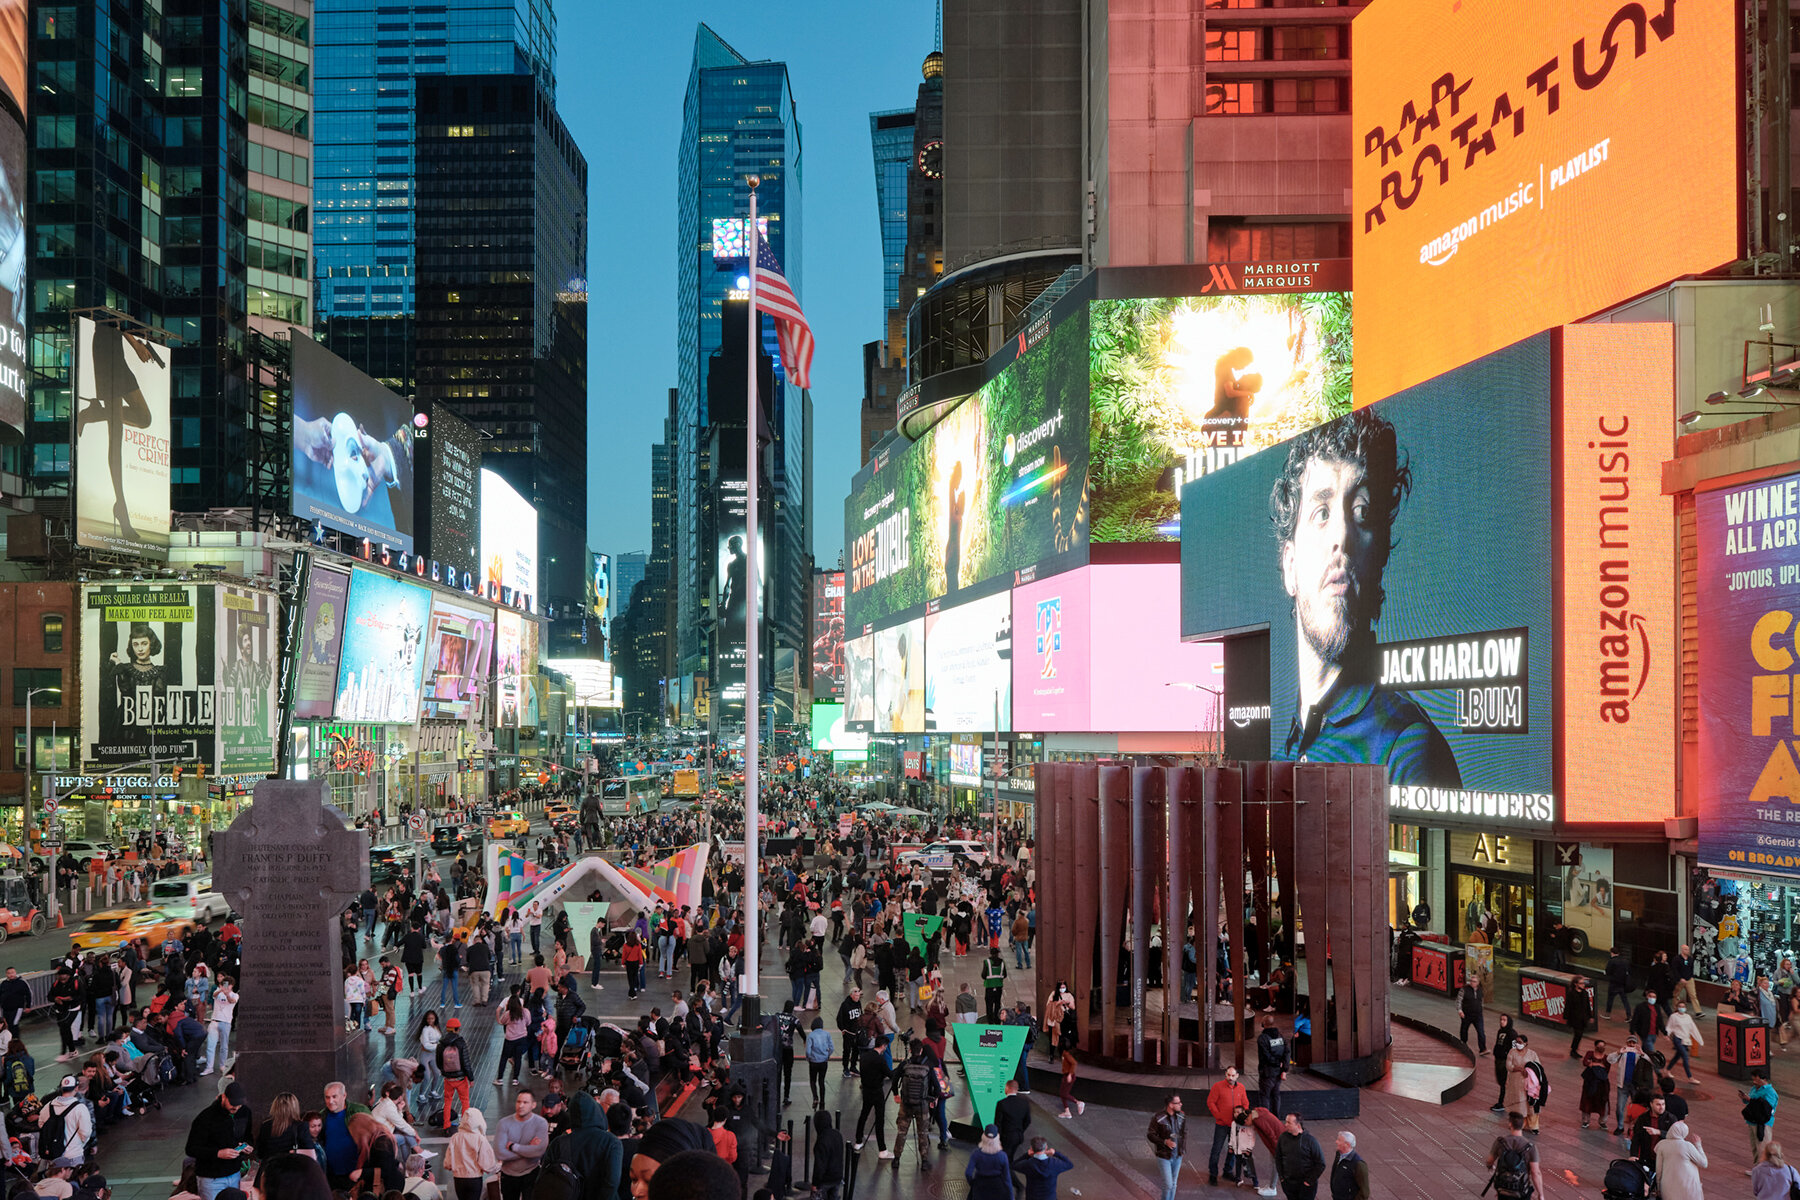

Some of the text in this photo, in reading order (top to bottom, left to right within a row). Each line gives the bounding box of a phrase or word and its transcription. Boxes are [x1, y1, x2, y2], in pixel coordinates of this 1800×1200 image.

[1549, 137, 1611, 191] PLAYLIST
[1419, 181, 1534, 264] amazon music
[1244, 262, 1321, 275] MARRIOTT
[1244, 276, 1312, 288] MARQUIS
[729, 290, 750, 300] 202
[1028, 309, 1052, 336] MARRIOTT
[1028, 324, 1050, 347] MARQUIS
[124, 428, 169, 453] PERFECT
[414, 429, 427, 438] LG
[1016, 408, 1064, 453] discovery+
[137, 446, 169, 467] CRIME
[1018, 455, 1046, 478] stream now
[1725, 479, 1800, 526] WINNE
[852, 527, 875, 569] LOVE
[1725, 517, 1800, 556] ALL ACR
[362, 536, 425, 577] 1540
[431, 559, 533, 614] BROADWAY
[852, 559, 875, 594] IN THE
[1588, 415, 1631, 724] amazon music
[89, 592, 187, 606] TIMES SQUARE CAN REALLY
[108, 607, 193, 619] MAKE YOU FEEL ALIVE!
[285, 605, 297, 653] MAC
[1750, 610, 1800, 672] C
[1380, 636, 1522, 686] JACK HARLOW
[279, 656, 290, 704] MAC
[122, 690, 213, 726] BEETLE
[1229, 706, 1261, 721] amazon
[1751, 673, 1800, 737] F
[275, 708, 284, 742] AC
[148, 744, 168, 754] GOOD
[329, 731, 376, 779] Disney
[105, 776, 180, 788] LUGGAGE
[1748, 738, 1800, 804] A
[1010, 778, 1036, 791] SEPHORA
[1414, 786, 1552, 821] OUTFITTERS
[1756, 808, 1776, 822] THE
[1471, 832, 1510, 865] AE
[1765, 835, 1796, 848] Gerald
[241, 853, 284, 863] FRANCIS
[297, 853, 332, 863] DUFFY
[1728, 849, 1746, 862] ON
[261, 930, 278, 938] LIFE
[291, 930, 321, 938] SERVICE
[1724, 924, 1735, 932] 32
[1521, 980, 1548, 1003] JERSEY
[1545, 995, 1566, 1017] BOYS
[987, 1029, 1003, 1037] Design
